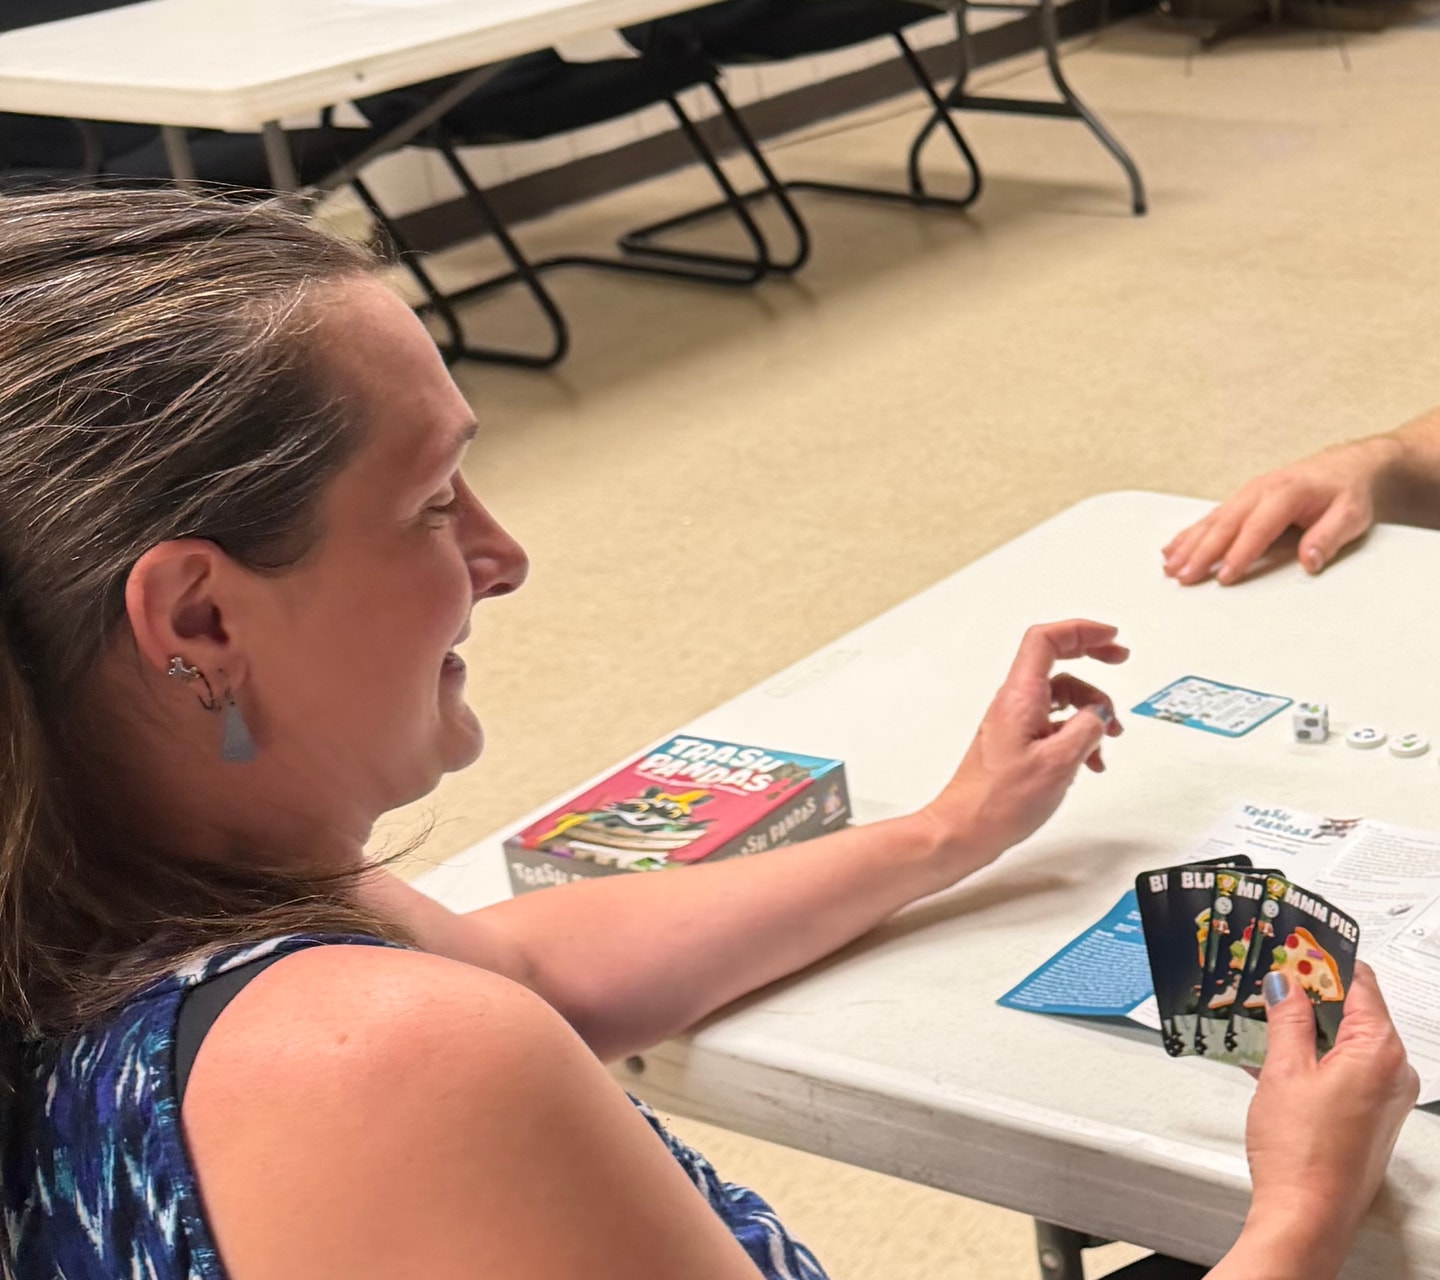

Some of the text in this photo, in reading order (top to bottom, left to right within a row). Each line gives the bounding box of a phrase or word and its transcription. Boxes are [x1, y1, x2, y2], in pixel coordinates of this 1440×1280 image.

[667, 737, 785, 772] TRASH
[636, 752, 775, 793] PANDAS
[1329, 910, 1359, 943] PIE!
